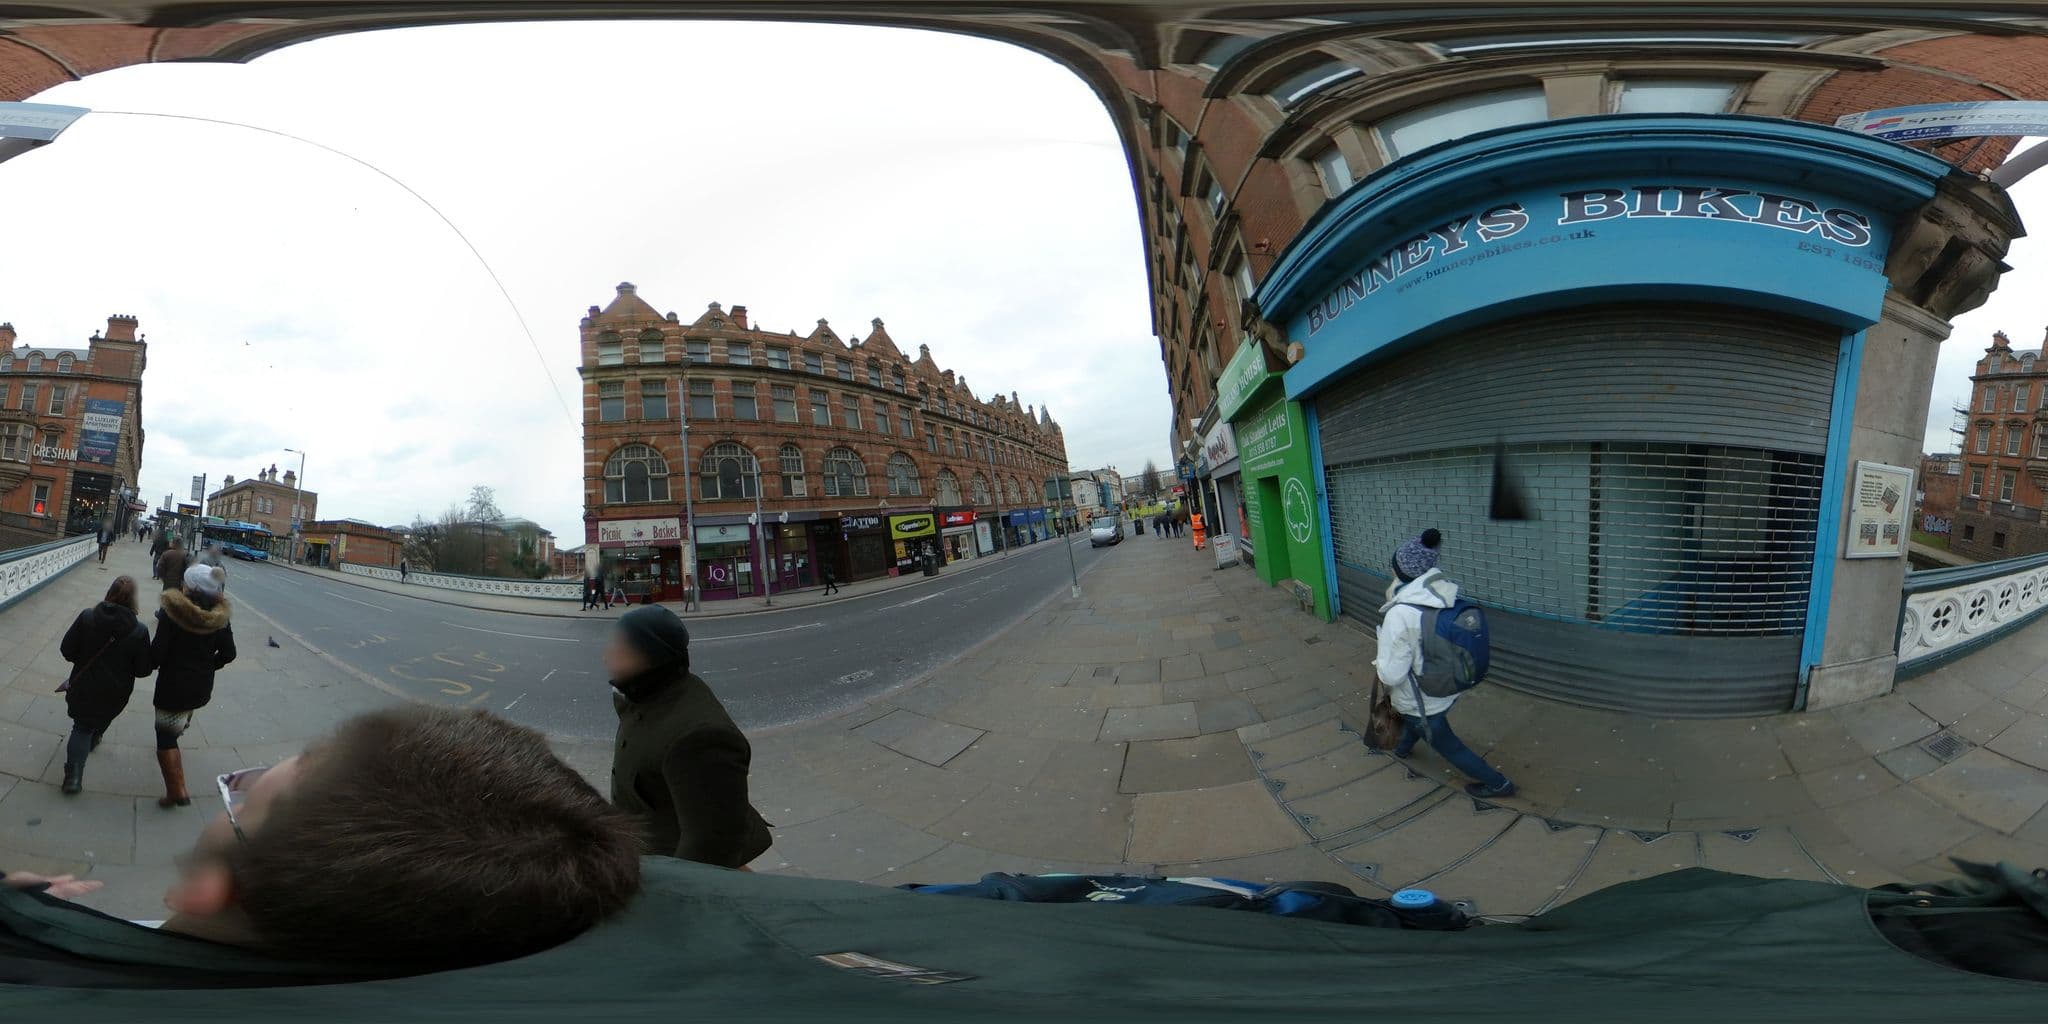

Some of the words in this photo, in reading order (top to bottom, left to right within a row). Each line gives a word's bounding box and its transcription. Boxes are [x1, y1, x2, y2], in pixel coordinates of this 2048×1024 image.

[1306, 202, 1529, 337] BUNNEYS
[1557, 185, 1871, 247] BIKES
[1395, 228, 1596, 295] www.bunneysbikes.co.uk
[1798, 240, 1835, 258] EST
[1844, 253, 1882, 273] 1893
[1239, 354, 1263, 391] HOUSE
[1268, 413, 1286, 432] Letts
[600, 526, 622, 541] Picnic
[652, 525, 678, 539] Basket
[708, 565, 725, 582] JQ
